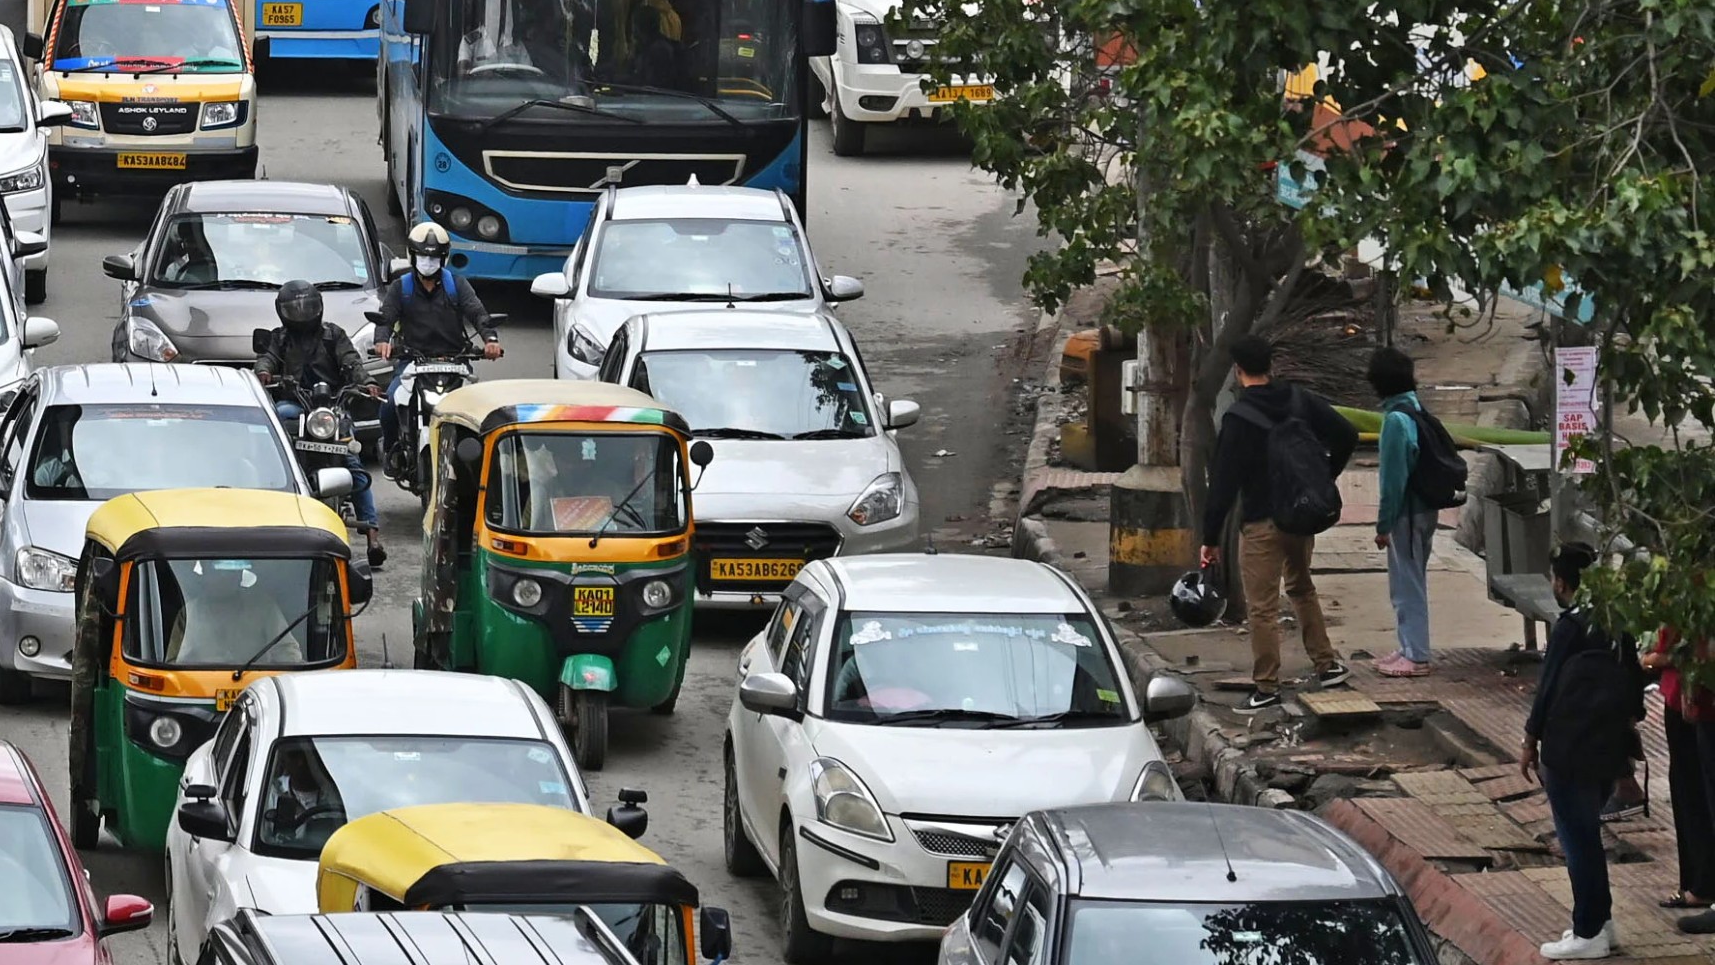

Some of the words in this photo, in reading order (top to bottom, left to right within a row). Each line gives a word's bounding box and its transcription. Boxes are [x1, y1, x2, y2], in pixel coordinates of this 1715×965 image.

[1564, 414, 1583, 423] SAP
[1558, 422, 1588, 431] BASIS
[579, 589, 611, 601] KA01
